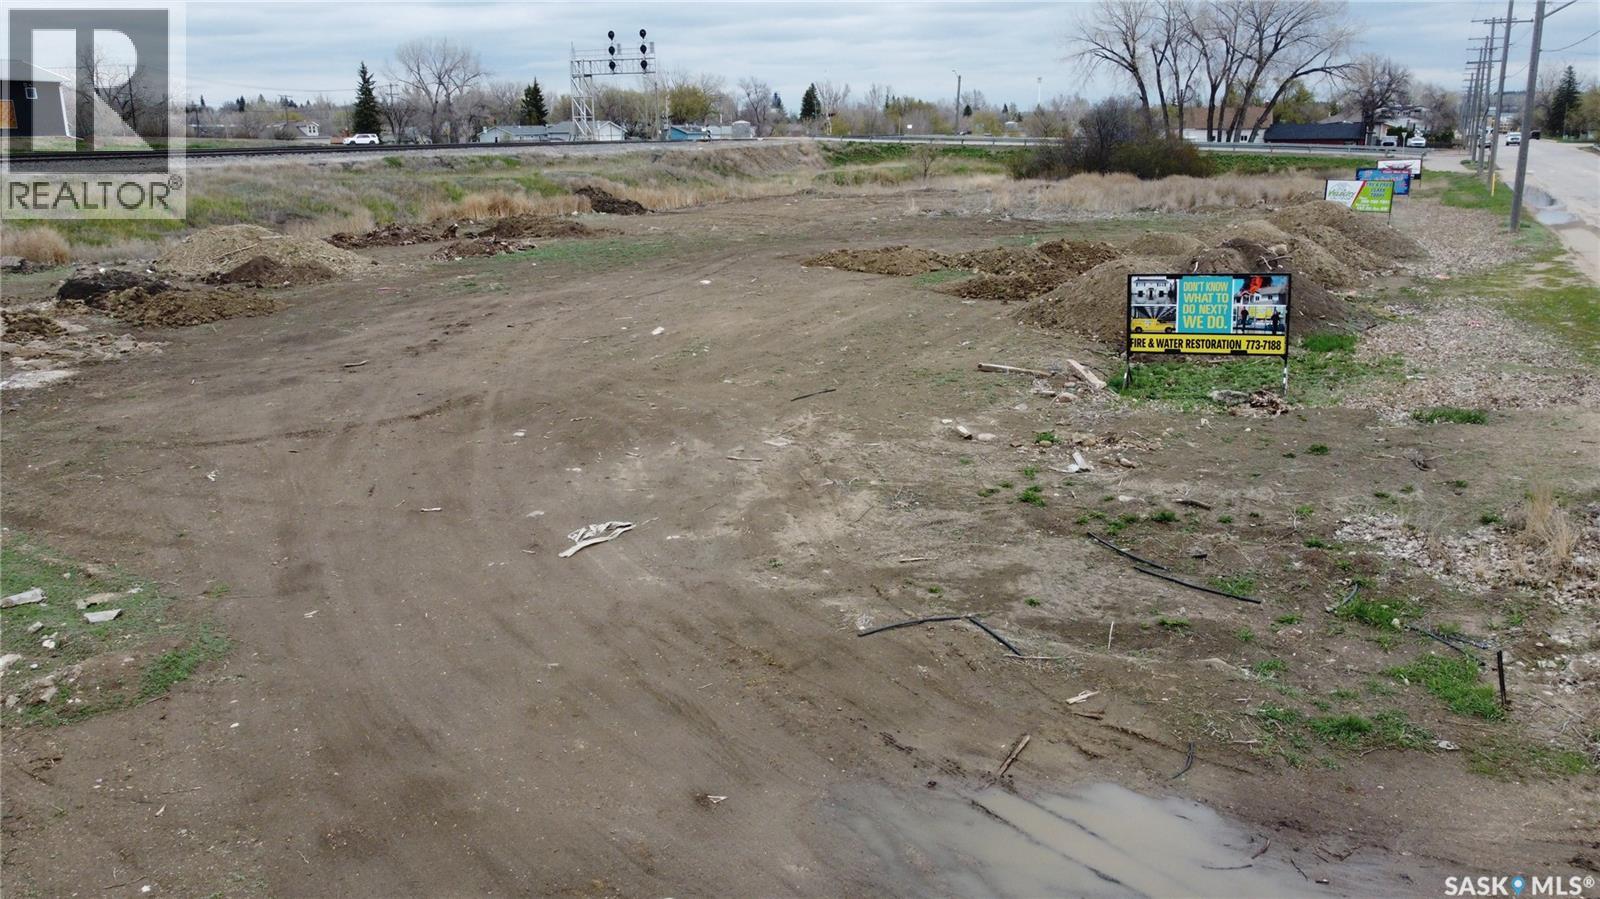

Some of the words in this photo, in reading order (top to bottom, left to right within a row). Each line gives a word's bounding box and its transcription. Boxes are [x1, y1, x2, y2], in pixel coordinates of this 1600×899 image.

[1184, 281, 1204, 291] DON'T
[1206, 281, 1228, 292] KNOW
[1184, 293, 1213, 303] WHAT
[1215, 293, 1228, 303] TO
[1183, 304, 1195, 314] DO
[1199, 304, 1227, 314] NEXT?
[1183, 315, 1203, 329] WE
[1207, 315, 1227, 329] DO.
[1131, 338, 1146, 348] FIRE
[1148, 338, 1154, 348] &
[1156, 338, 1183, 349] WATER
[1186, 338, 1241, 350] RESTORATION
[1246, 339, 1281, 351] 773-7188
